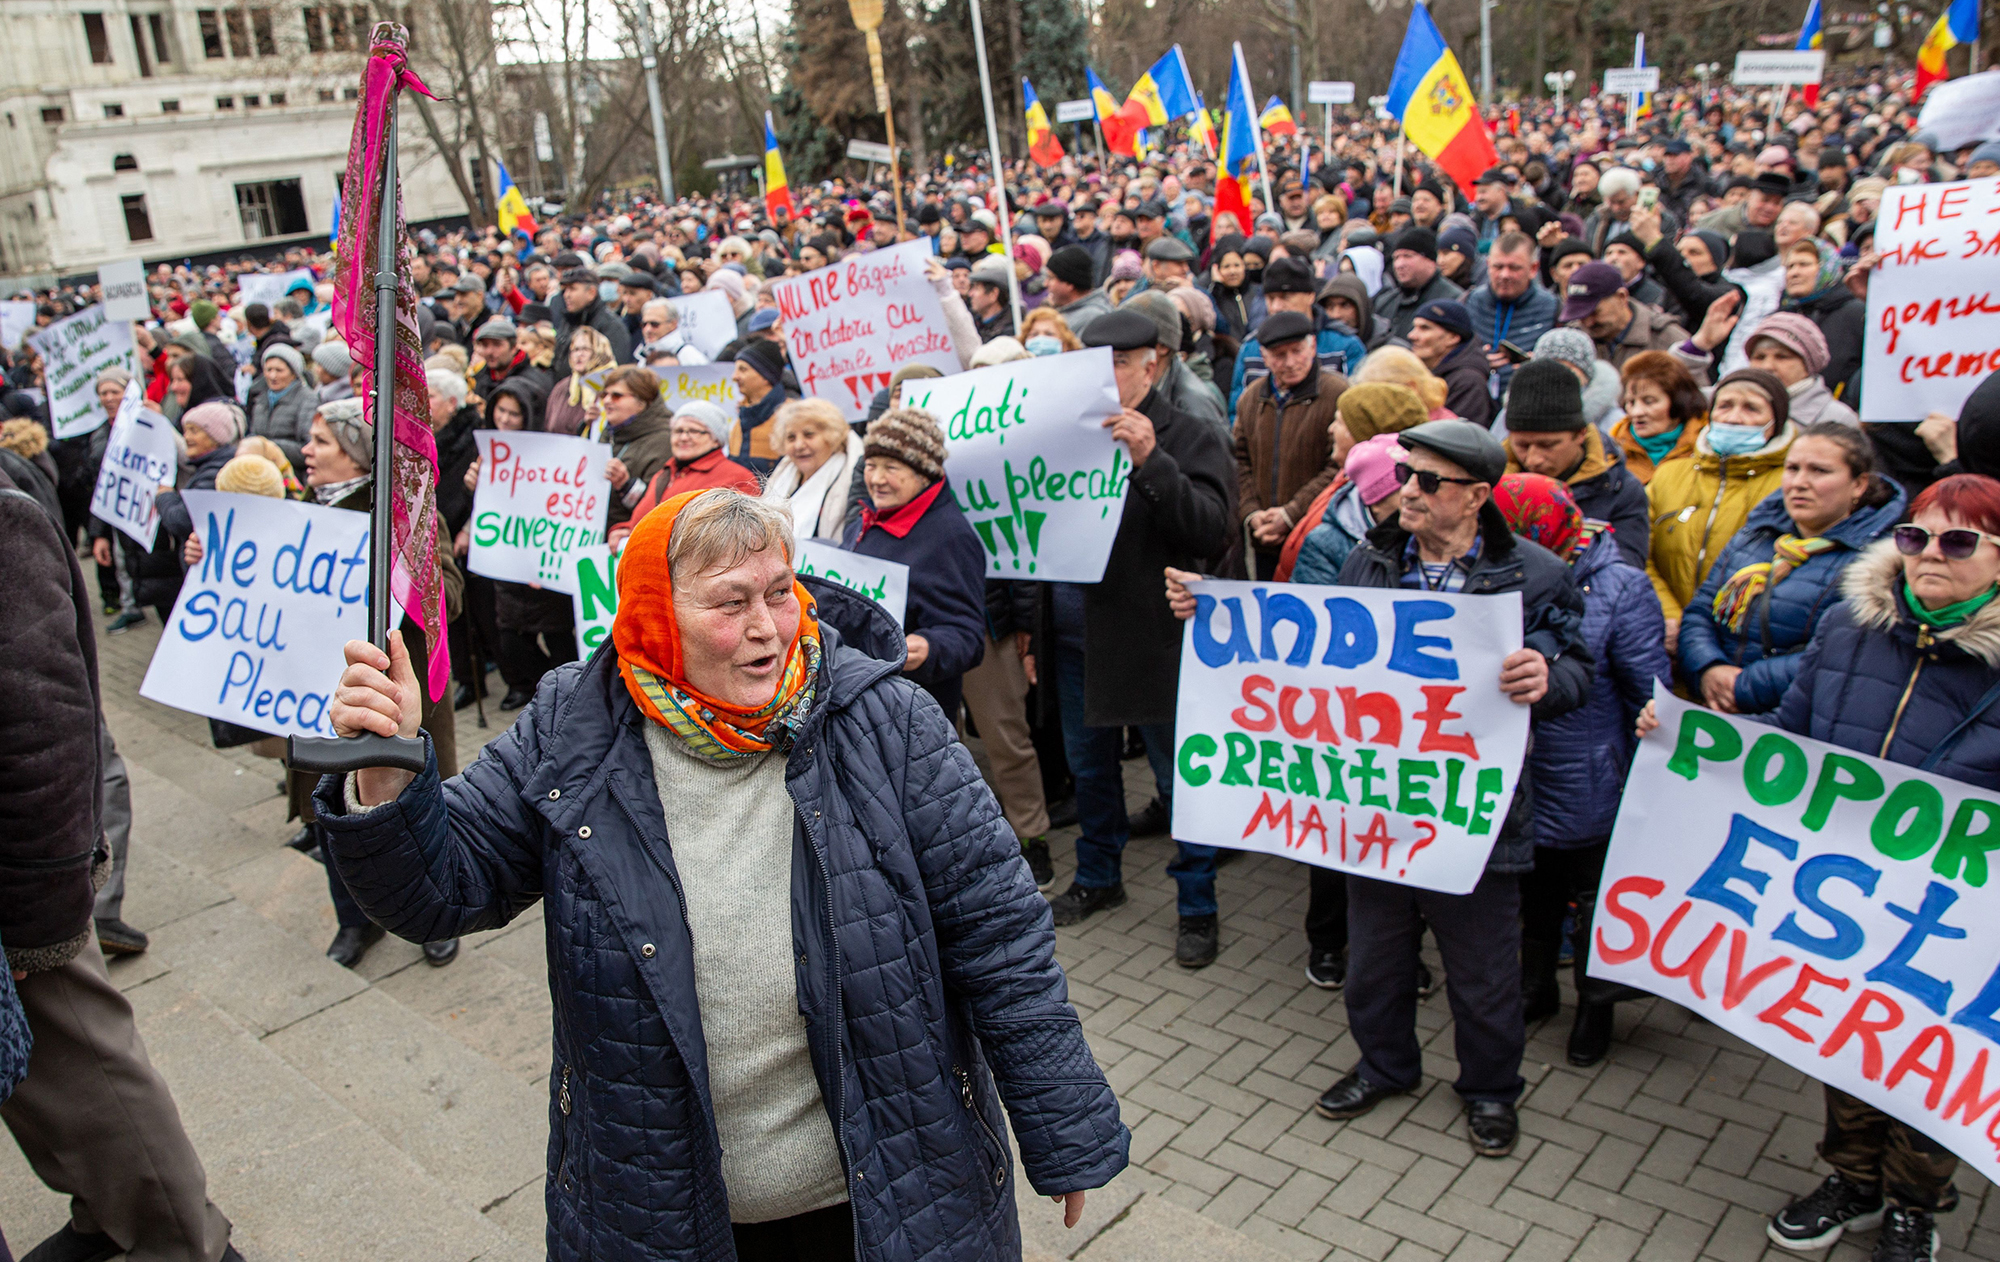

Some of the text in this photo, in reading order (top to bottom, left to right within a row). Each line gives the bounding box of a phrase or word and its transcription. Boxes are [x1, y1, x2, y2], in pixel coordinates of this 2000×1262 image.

[490, 438, 588, 498] Poporul
[546, 491, 597, 521] este
[202, 508, 257, 588] Ne
